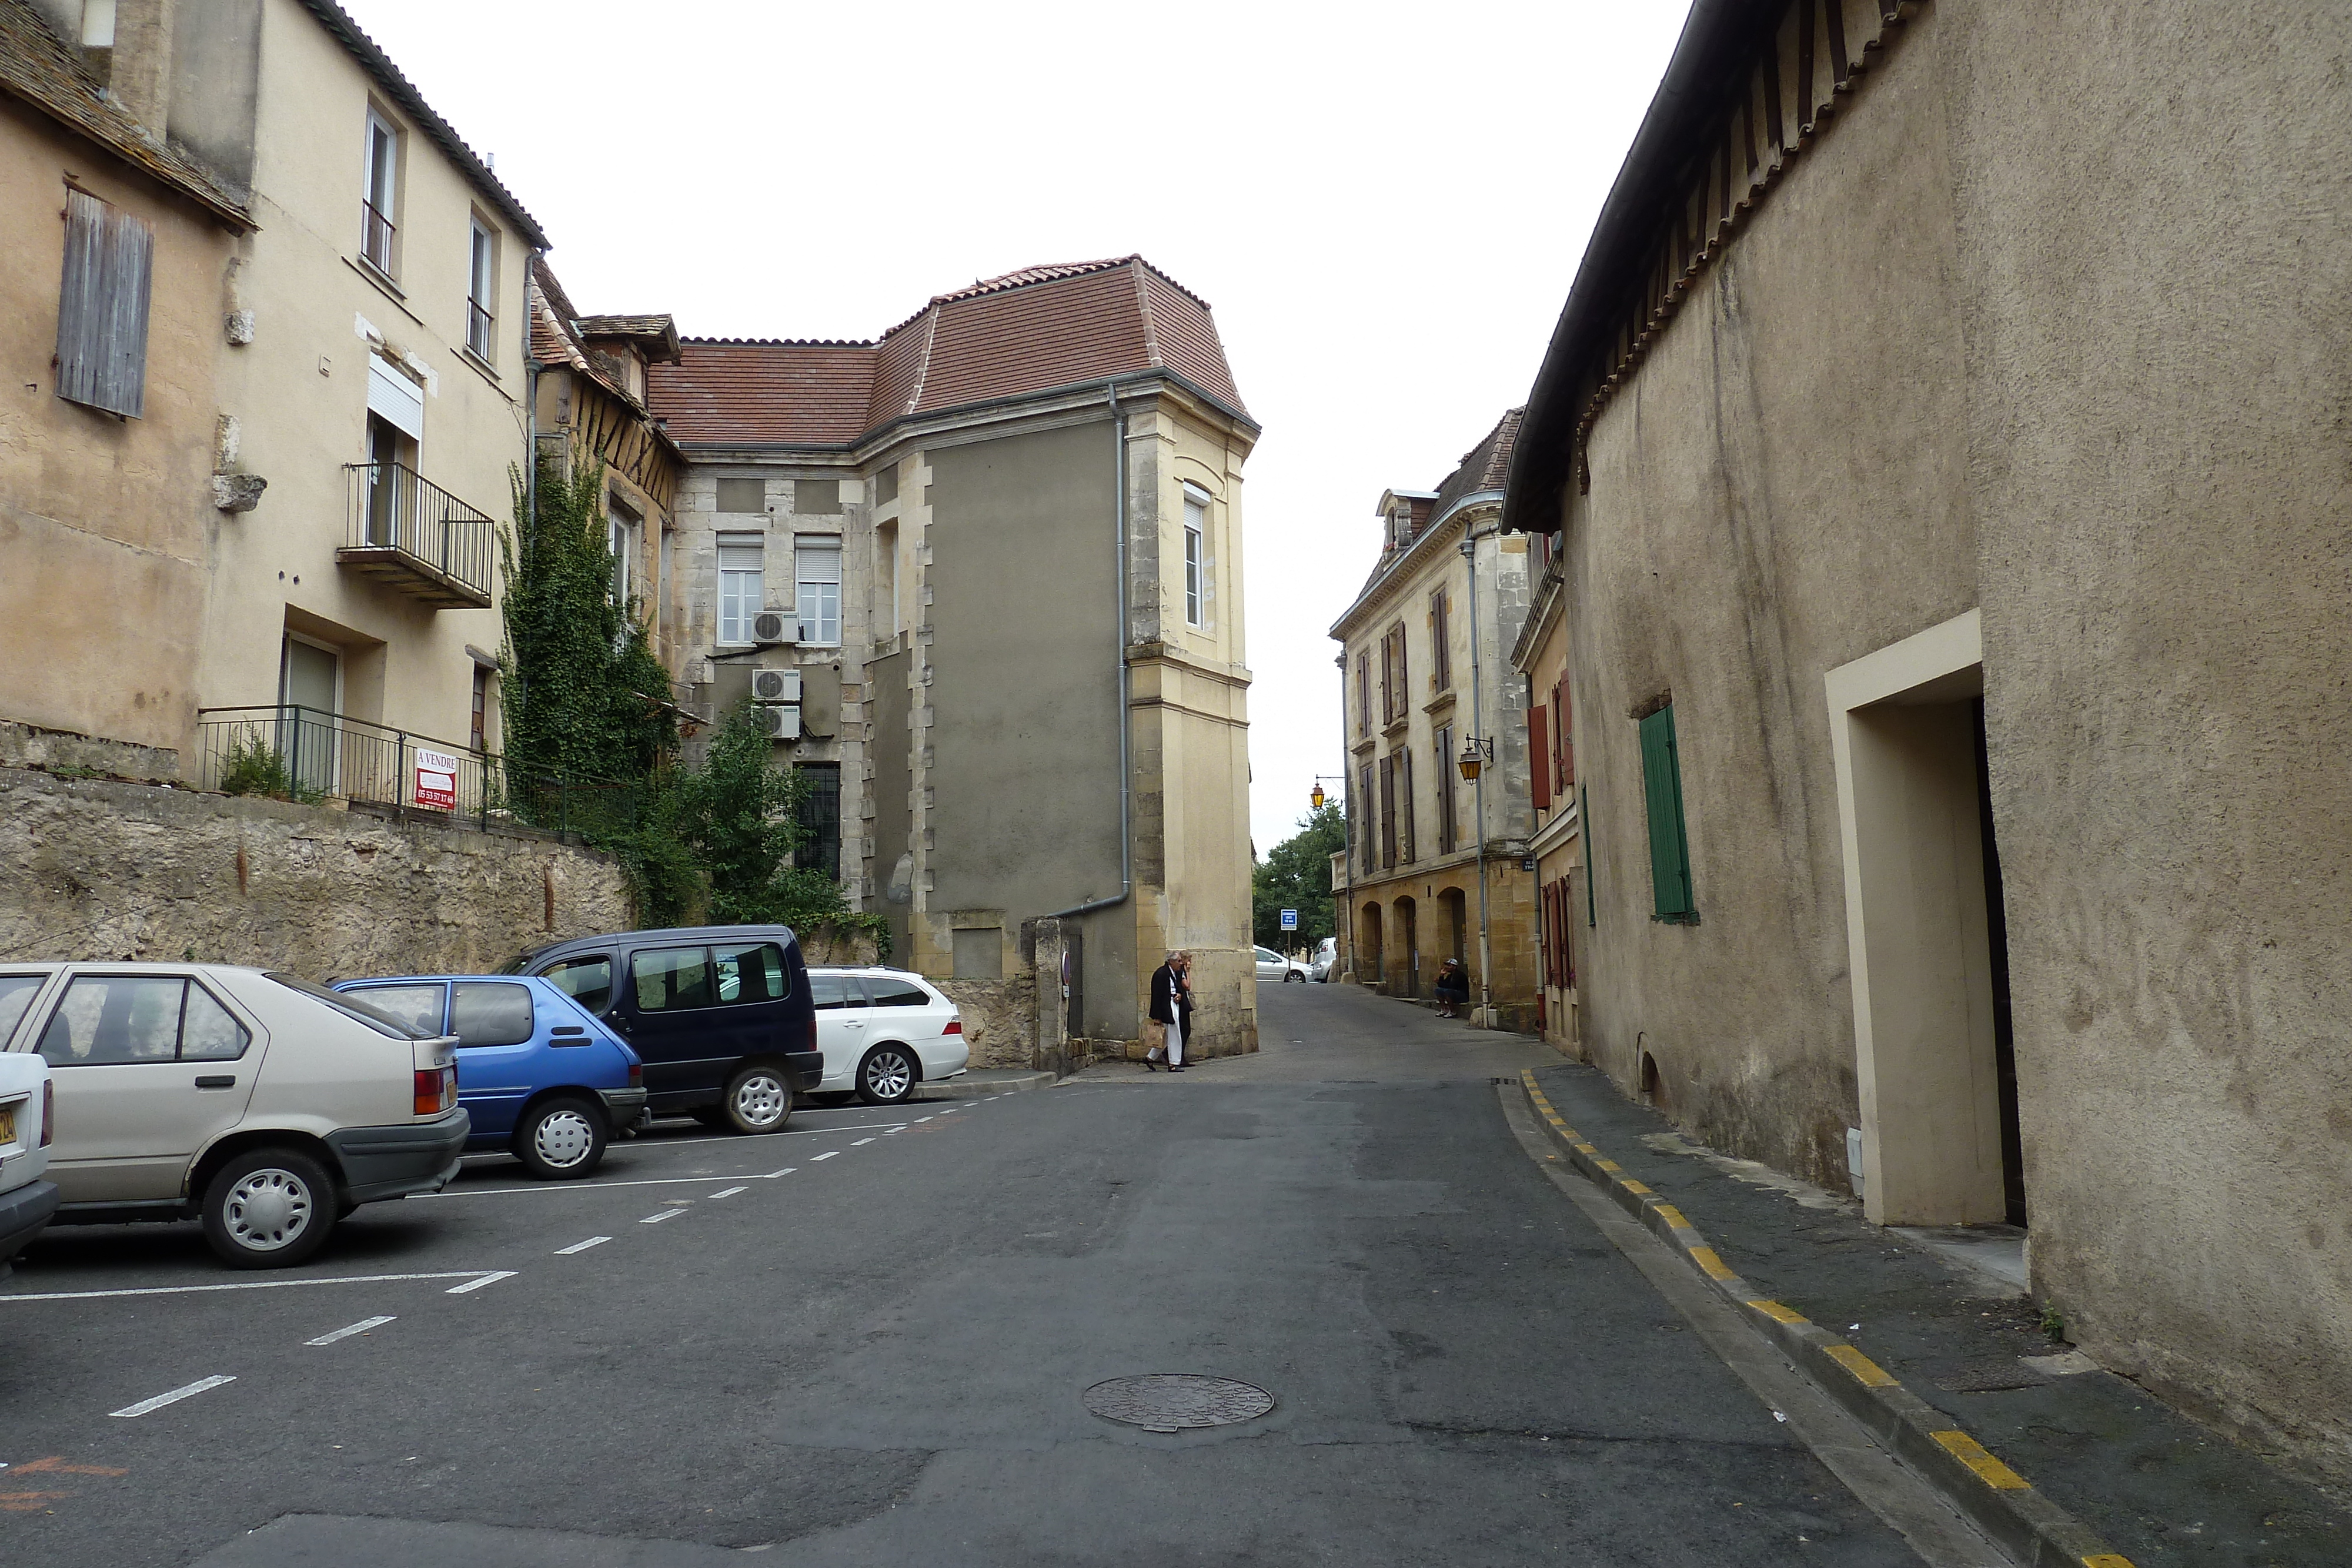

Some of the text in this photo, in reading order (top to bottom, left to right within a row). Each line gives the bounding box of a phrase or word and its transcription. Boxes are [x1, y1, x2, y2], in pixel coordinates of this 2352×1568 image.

[418, 752, 455, 769] A VENDRE
[418, 789, 425, 798] 05
[426, 791, 433, 799] 53
[433, 792, 440, 801] 57
[441, 794, 447, 802] 17
